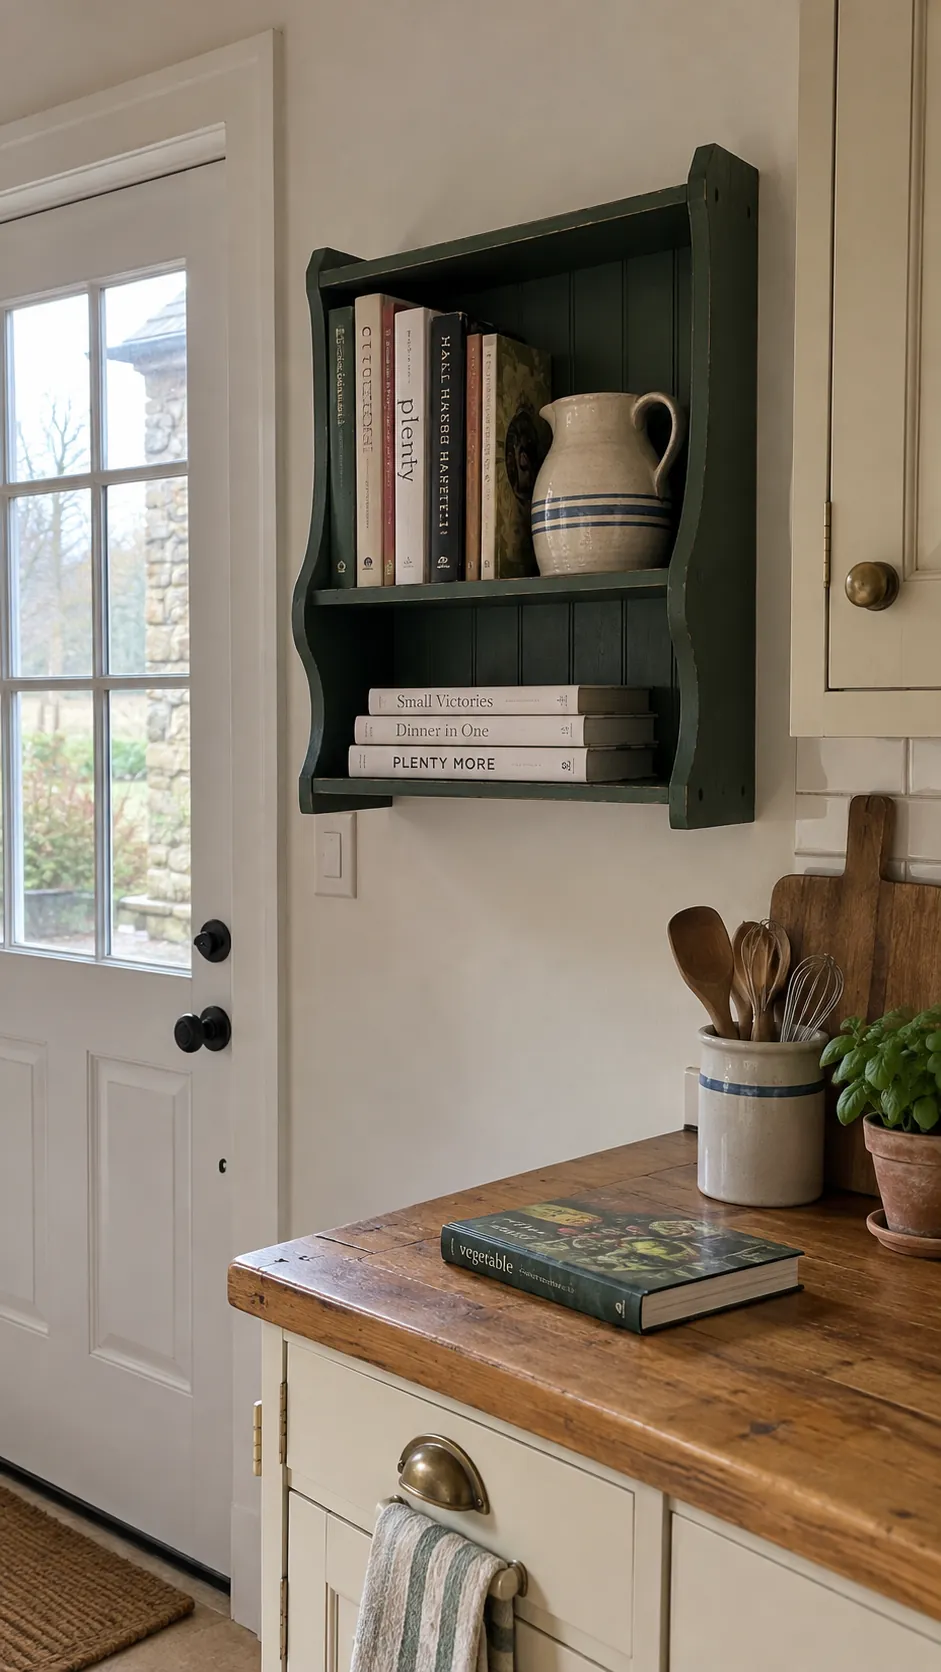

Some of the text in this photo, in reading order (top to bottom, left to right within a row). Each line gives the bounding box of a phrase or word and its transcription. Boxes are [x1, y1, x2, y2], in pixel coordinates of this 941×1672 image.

[397, 398, 419, 482] plenty
[397, 694, 432, 708] Small
[436, 694, 494, 708] Victories
[395, 723, 489, 738] Dinner in One
[393, 756, 496, 770] PLENTY MORE
[459, 1245, 513, 1274] vegetable
